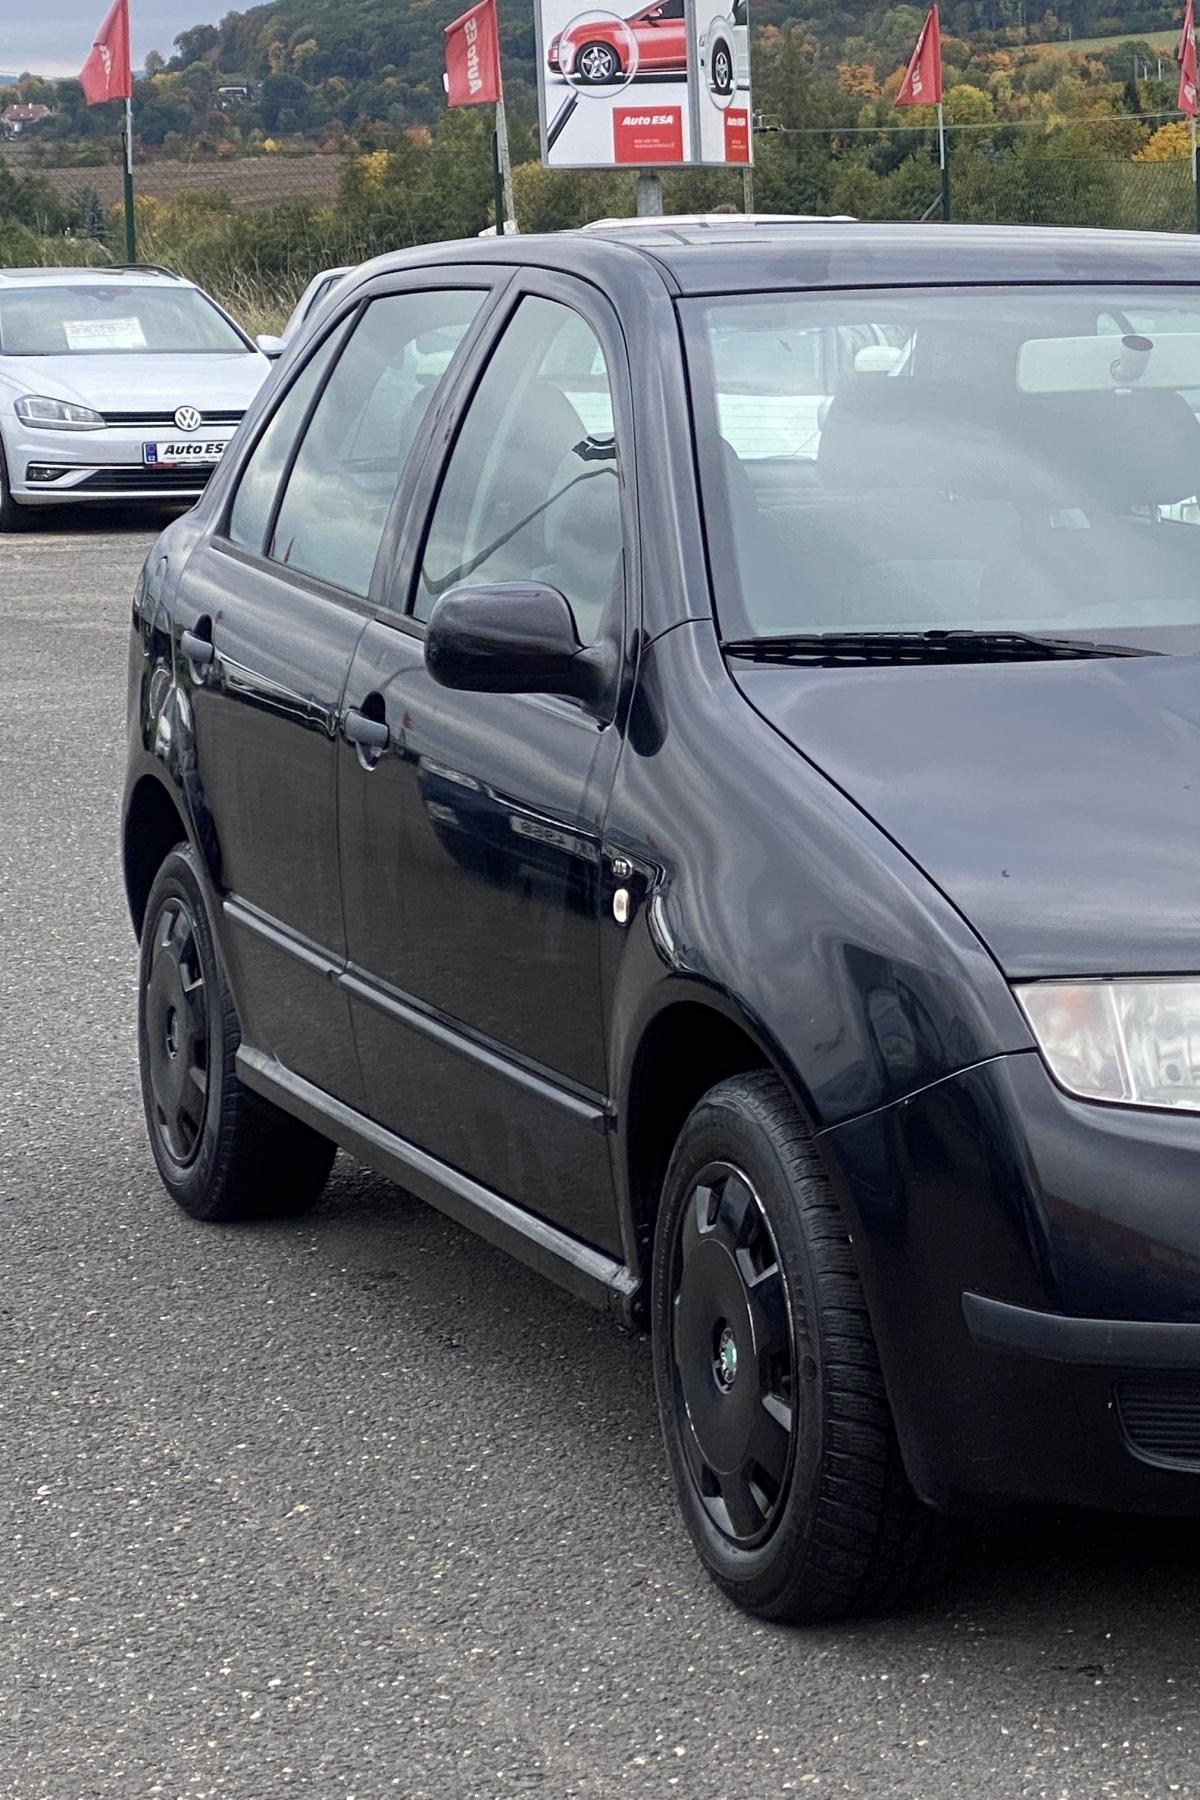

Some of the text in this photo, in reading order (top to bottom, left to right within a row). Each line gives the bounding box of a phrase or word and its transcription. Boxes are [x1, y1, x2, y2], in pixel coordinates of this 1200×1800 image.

[622, 115, 674, 126] Auto ESA
[163, 443, 224, 455] Auto ES
